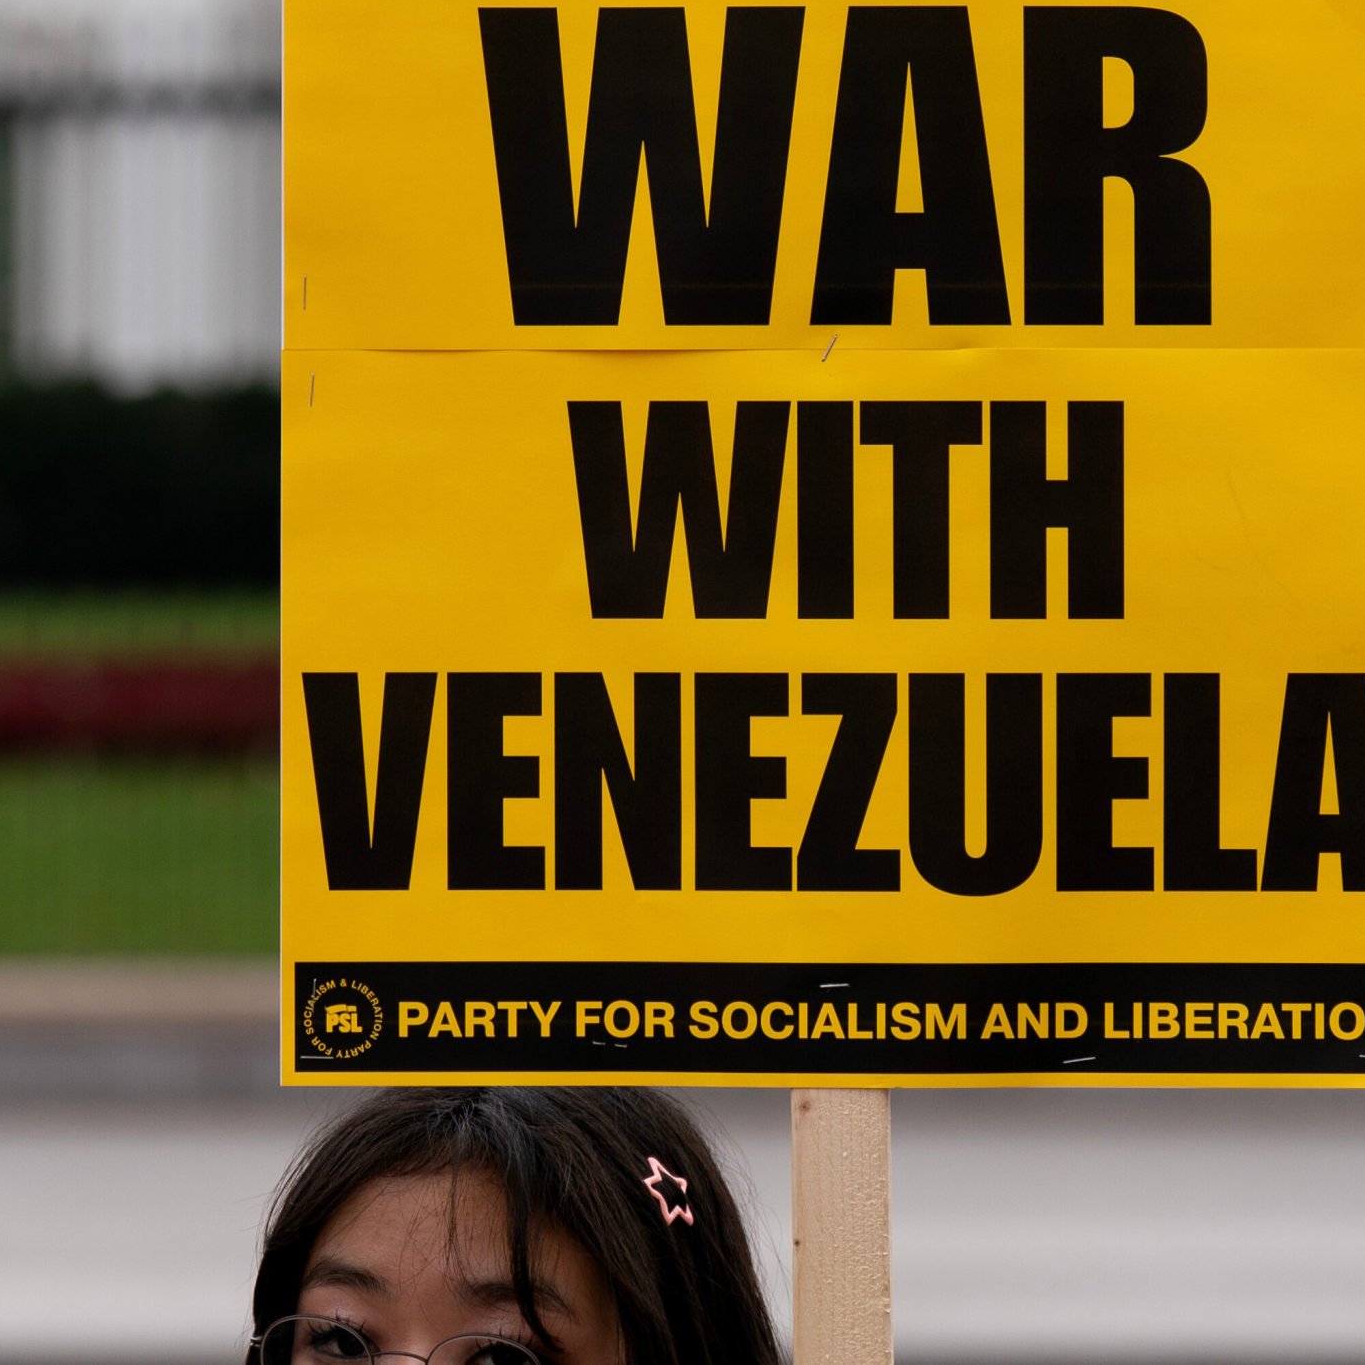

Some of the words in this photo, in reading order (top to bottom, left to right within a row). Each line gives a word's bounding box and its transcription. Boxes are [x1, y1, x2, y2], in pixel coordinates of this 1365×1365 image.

[477, 5, 1212, 326] WAR
[566, 400, 1125, 620] WITH
[339, 978, 347, 987] &
[303, 979, 336, 1035] SOCIALISM
[325, 1012, 363, 1033] PSL
[351, 980, 383, 1040] LIBERATION
[398, 1001, 562, 1038] PARTY
[575, 999, 675, 1039] FOR
[688, 1000, 967, 1041] SOCIALISM
[980, 1002, 1089, 1040] AND
[311, 1036, 333, 1056] FOR
[335, 1039, 373, 1059] PARTY
